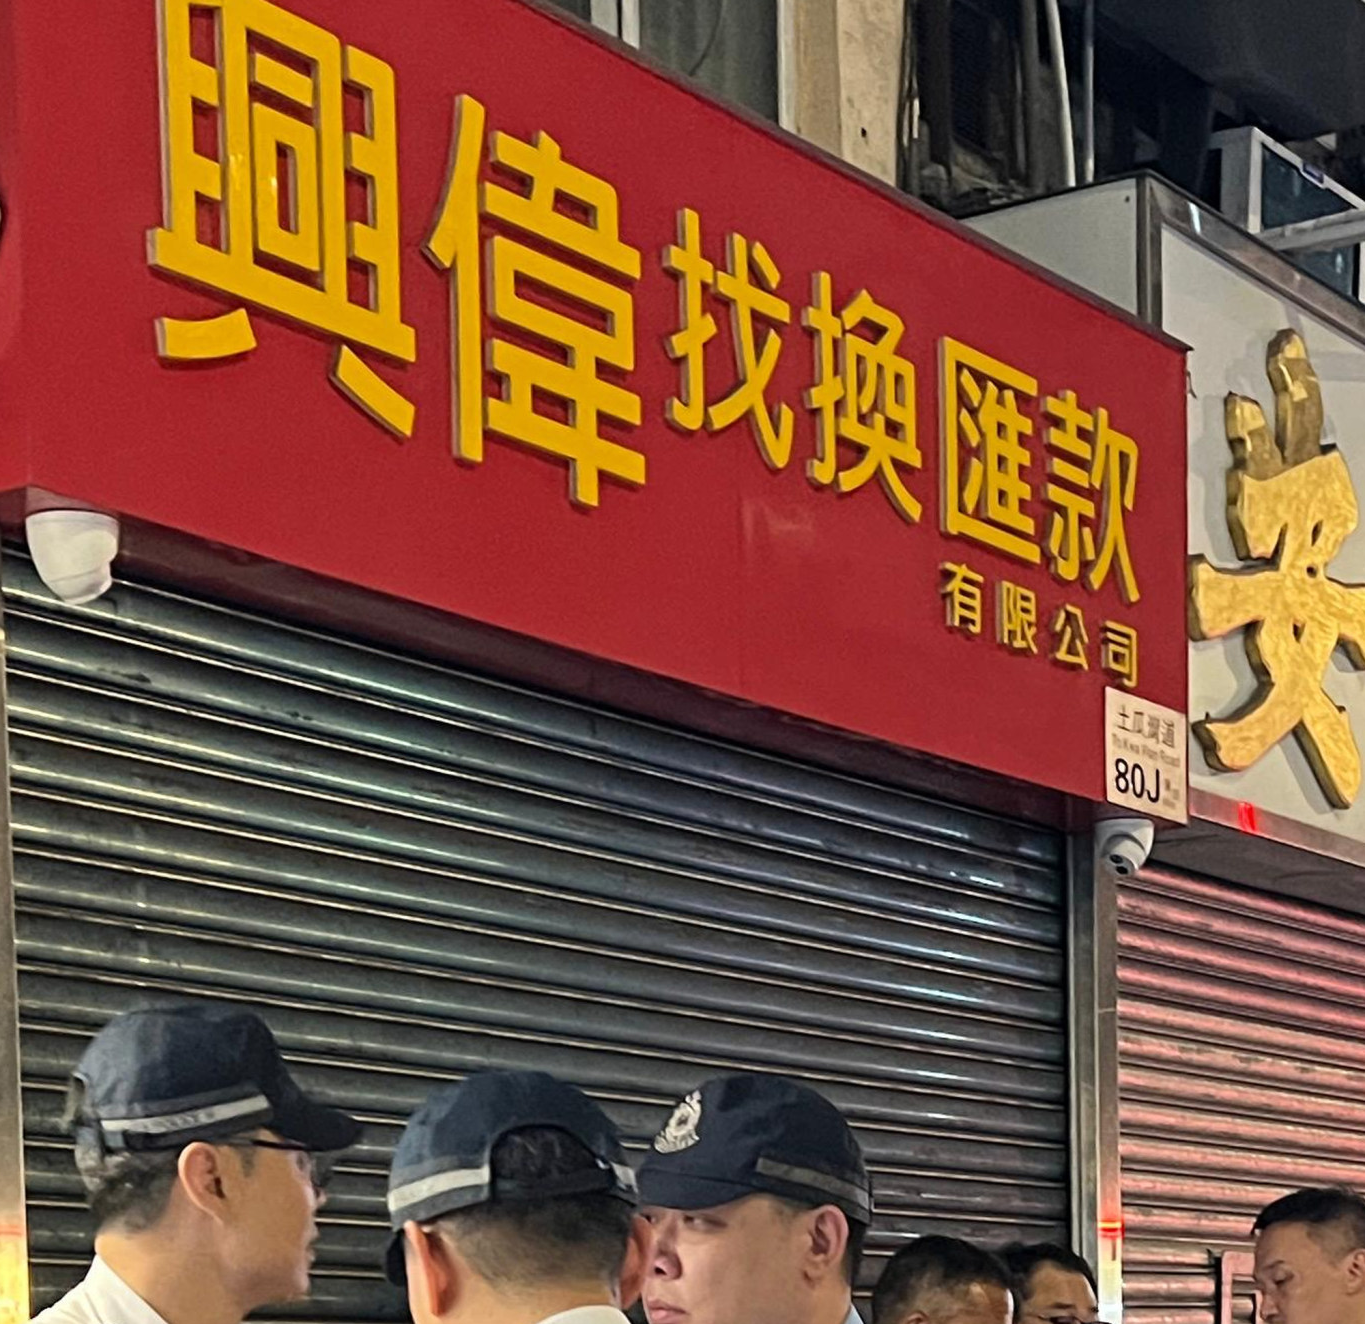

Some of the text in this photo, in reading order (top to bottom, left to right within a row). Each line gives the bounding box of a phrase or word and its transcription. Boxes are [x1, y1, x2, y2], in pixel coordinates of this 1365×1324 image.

[146, 0, 1140, 603] 興偉找換匯款
[939, 561, 1138, 688] 有限公司
[1115, 758, 1160, 803] 80J
